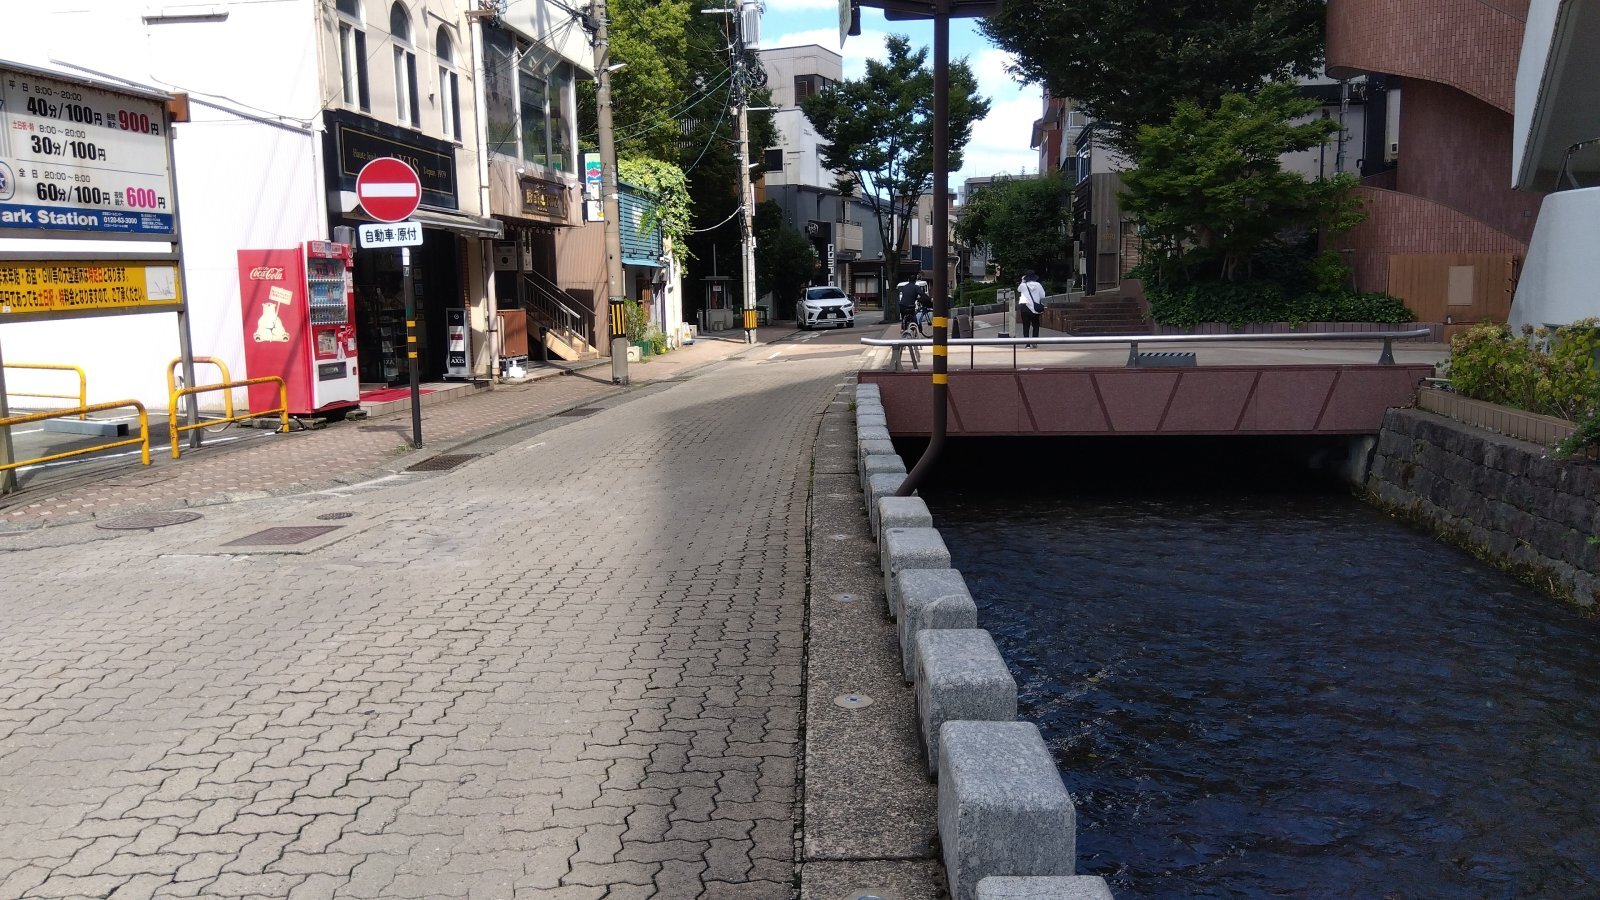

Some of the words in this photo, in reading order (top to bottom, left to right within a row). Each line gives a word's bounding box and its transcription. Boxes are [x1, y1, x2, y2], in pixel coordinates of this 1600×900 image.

[30, 134, 107, 162] 30分/100円
[36, 182, 111, 206] 60分/100円
[2, 209, 33, 223] ark
[38, 210, 98, 226] Station
[365, 227, 417, 243] 自動車・原付
[249, 266, 284, 280] Coca-Cola
